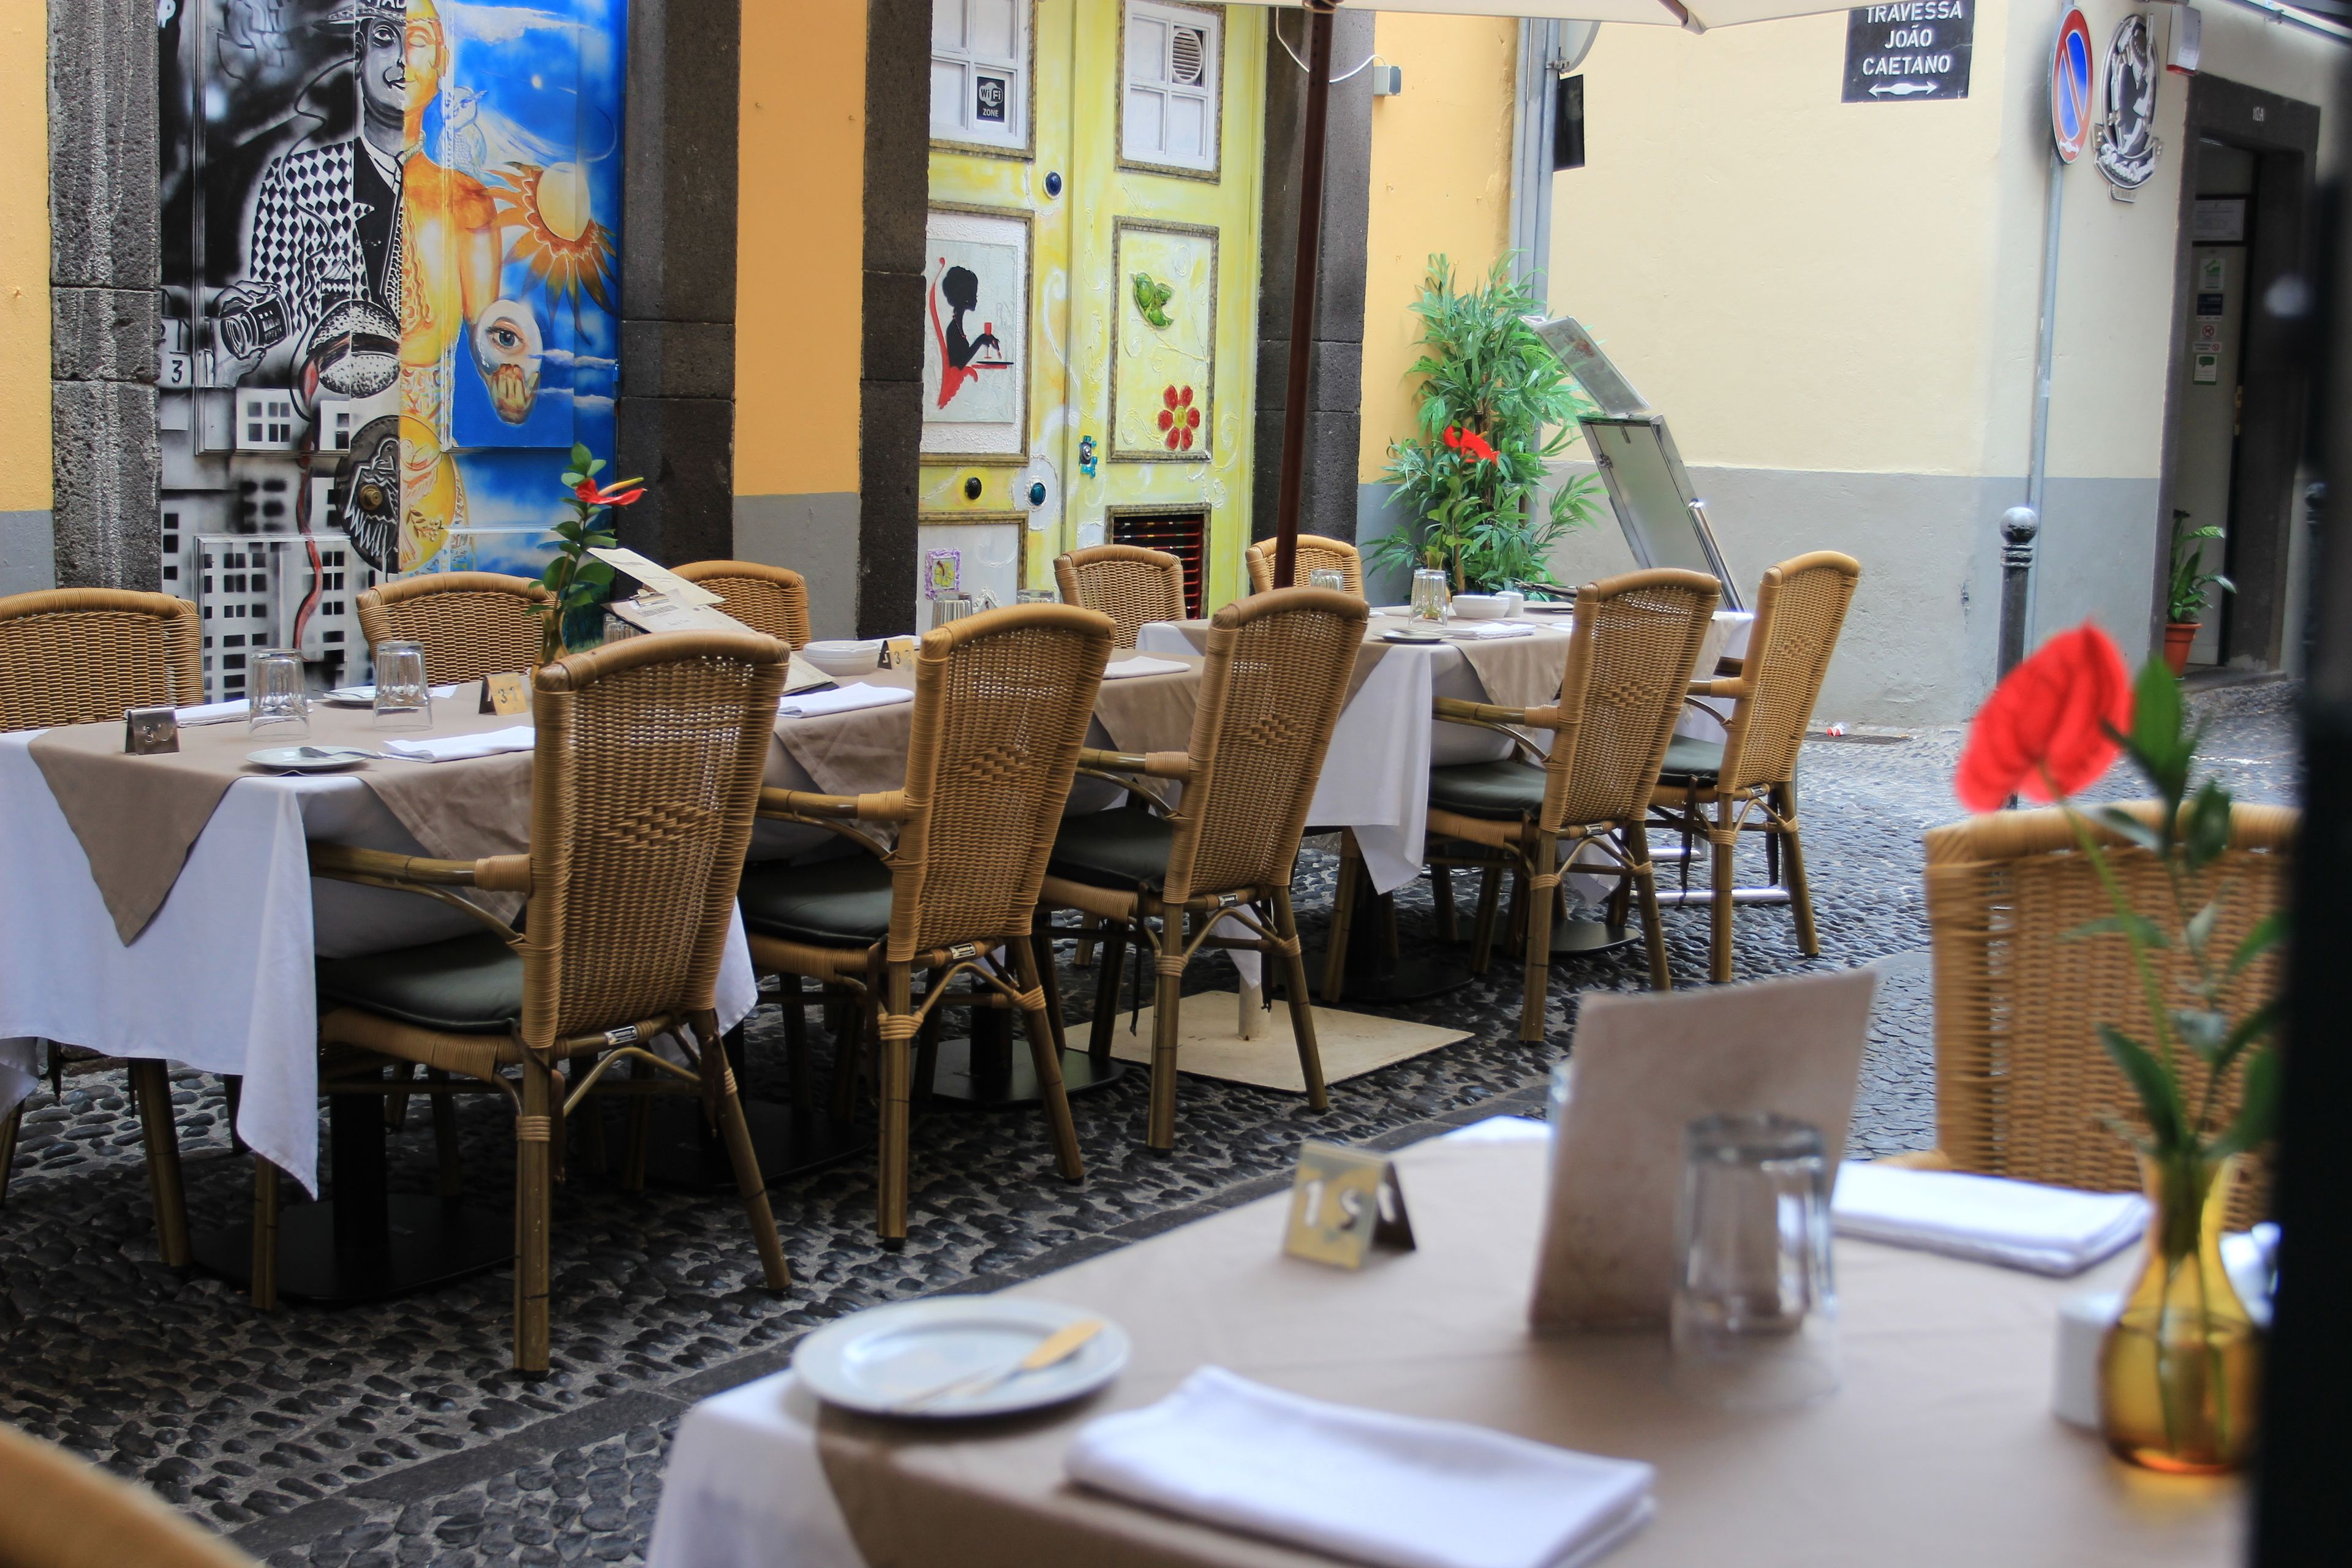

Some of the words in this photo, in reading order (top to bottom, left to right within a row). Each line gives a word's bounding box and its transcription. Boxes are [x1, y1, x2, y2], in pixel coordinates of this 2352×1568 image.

[1866, 1, 1962, 24] TRAVESSA
[1884, 24, 1932, 49] JOÃO
[1862, 55, 1950, 76] CAETANO
[982, 108, 998, 117] ZONE
[172, 360, 183, 384] 3
